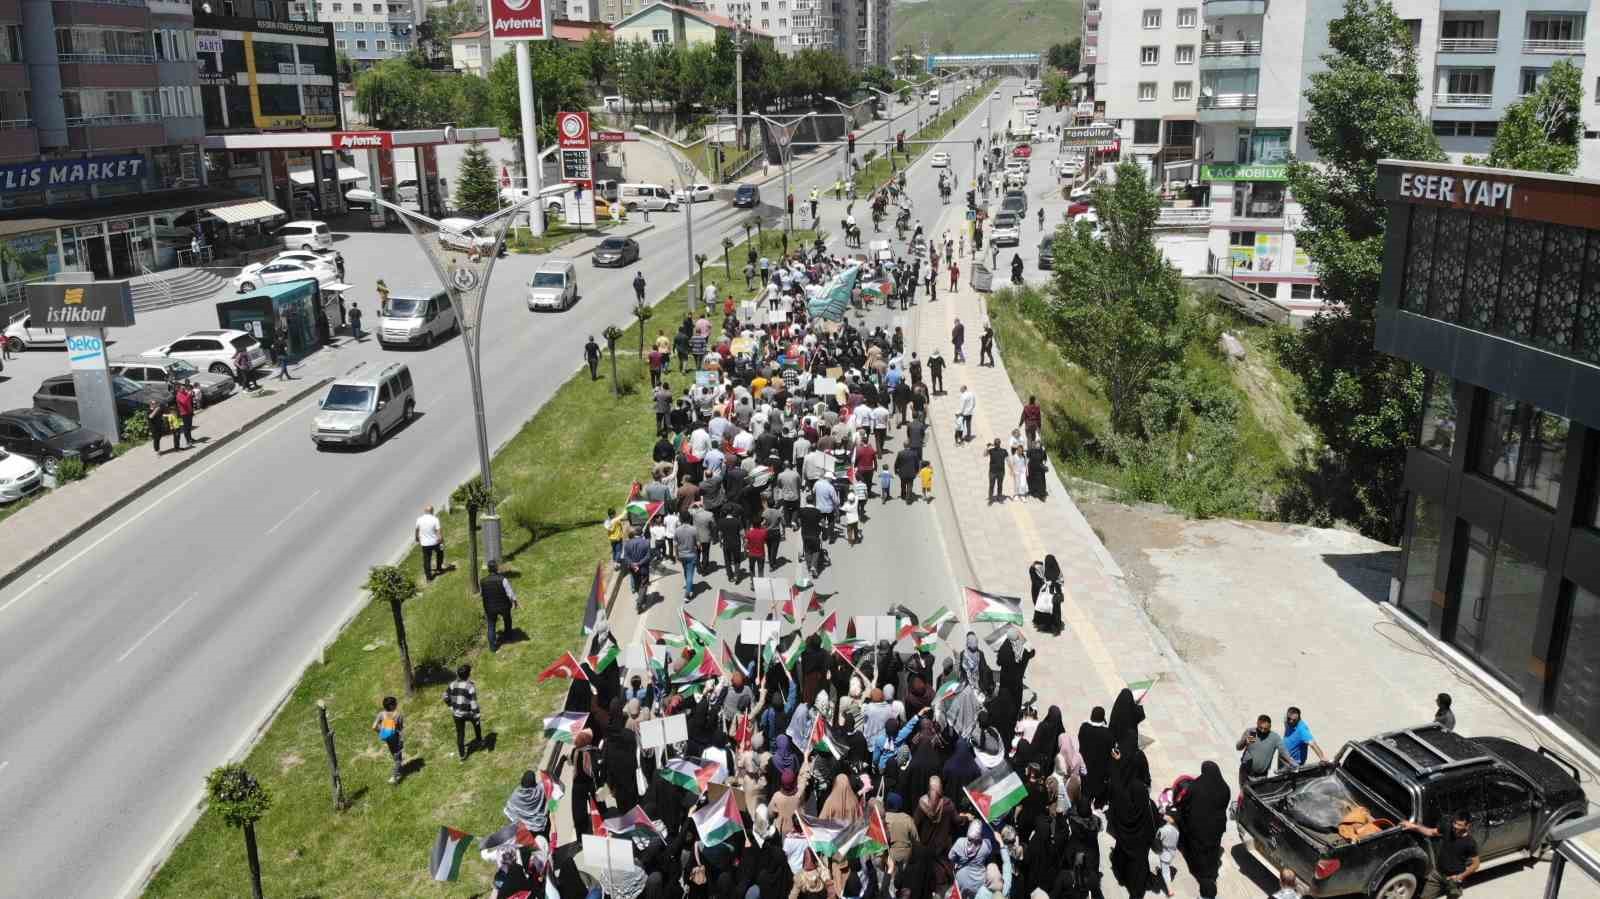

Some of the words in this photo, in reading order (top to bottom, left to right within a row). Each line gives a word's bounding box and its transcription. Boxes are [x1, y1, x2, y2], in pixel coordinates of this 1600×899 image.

[494, 17, 542, 32] Aytemiz
[340, 135, 382, 148] Aytemiz
[49, 160, 142, 184] MARKET
[1400, 173, 1456, 202] ESER
[1462, 179, 1514, 209] YAPI
[47, 306, 106, 322] istikbal
[67, 336, 101, 351] beko
